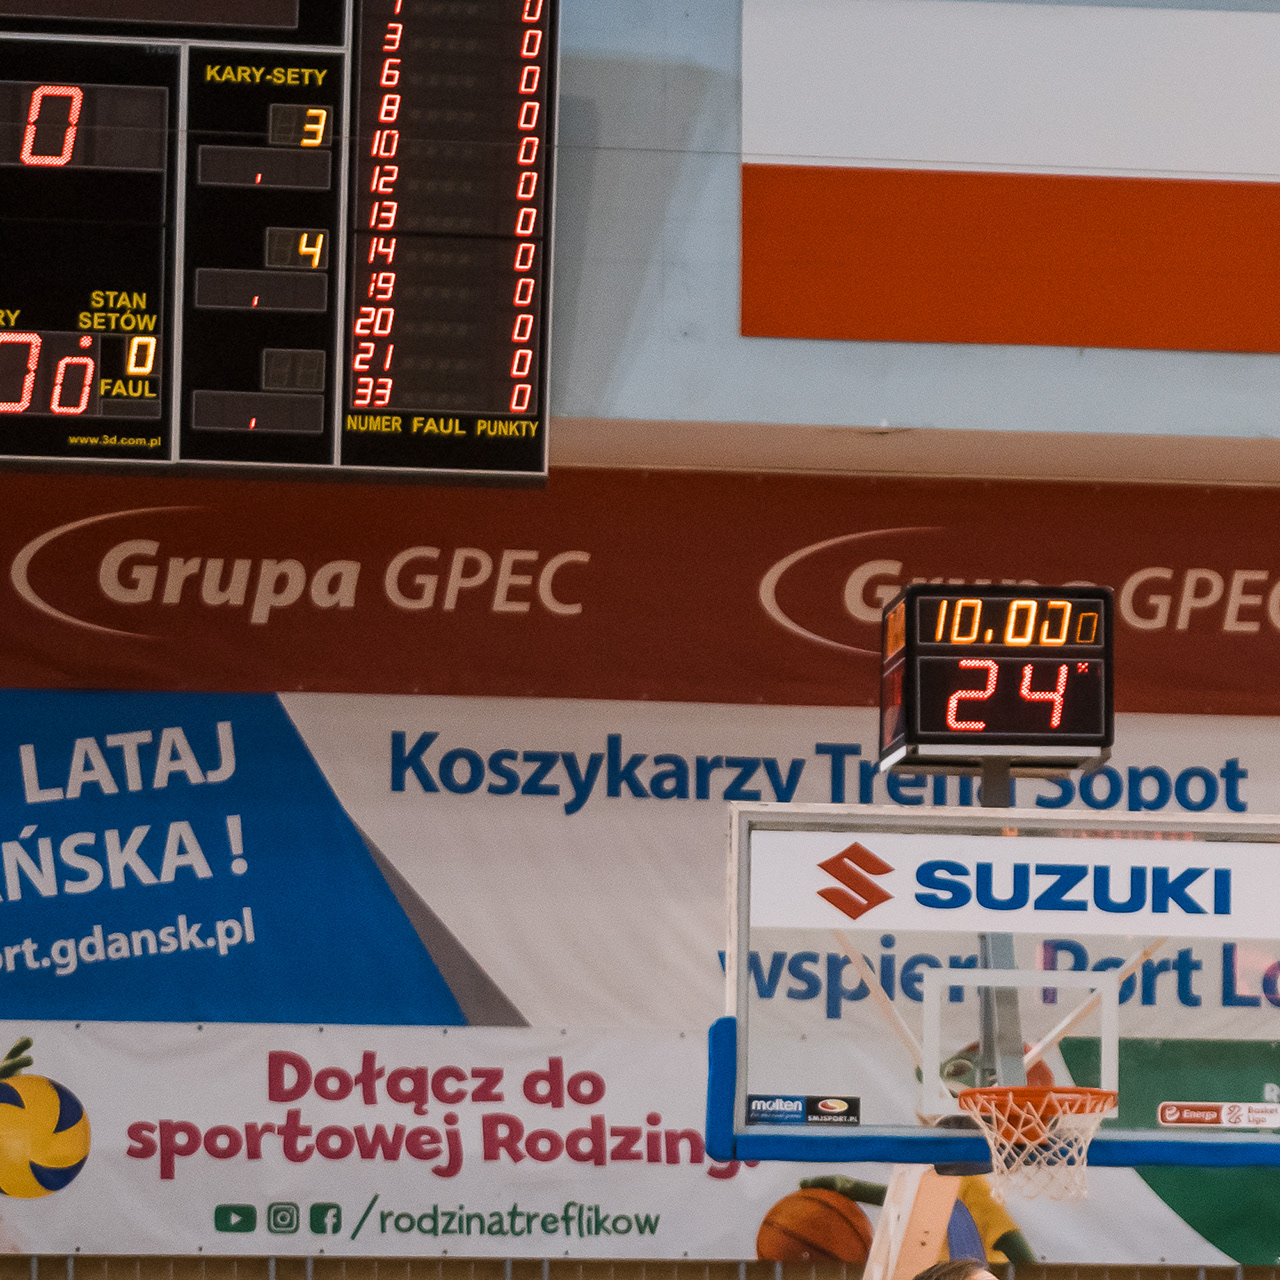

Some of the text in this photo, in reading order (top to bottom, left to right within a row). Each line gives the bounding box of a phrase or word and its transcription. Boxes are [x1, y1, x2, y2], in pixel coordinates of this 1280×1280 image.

[382, 23, 542, 59] 3 0
[206, 65, 328, 86] KARY-SETY
[379, 58, 541, 94] 6 0
[20, 85, 83, 166] 0
[301, 108, 327, 147] 3
[378, 93, 540, 131] 8 0
[371, 130, 539, 165] 10 0
[370, 165, 538, 201] 12 0
[369, 201, 537, 237] 13 0
[298, 233, 324, 269] 4
[368, 237, 536, 272] 14 0
[91, 290, 147, 309] STAN
[368, 272, 535, 307] 19 0
[78, 308, 157, 331] SETÓW
[354, 307, 534, 343] 20 0
[126, 336, 157, 375] 0
[353, 342, 533, 378] 21 0
[100, 379, 157, 397] FAUL
[353, 377, 531, 413] 33 0
[69, 435, 161, 447] www.3d.com.pl
[347, 415, 539, 437] NUMER FAUL PUNKTY
[98, 539, 591, 625] Grupa GPEC
[946, 658, 1069, 731] 24
[20, 720, 236, 805] LATAJ
[390, 731, 805, 815] Koszykarzy
[0, 814, 213, 901] ŃSKA
[914, 860, 1231, 914] SUZUKI
[0, 906, 256, 976] rt.gdansk.pl
[267, 1049, 606, 1115] Dołącz do
[751, 1099, 802, 1111] molten
[126, 1109, 464, 1179] sportowej
